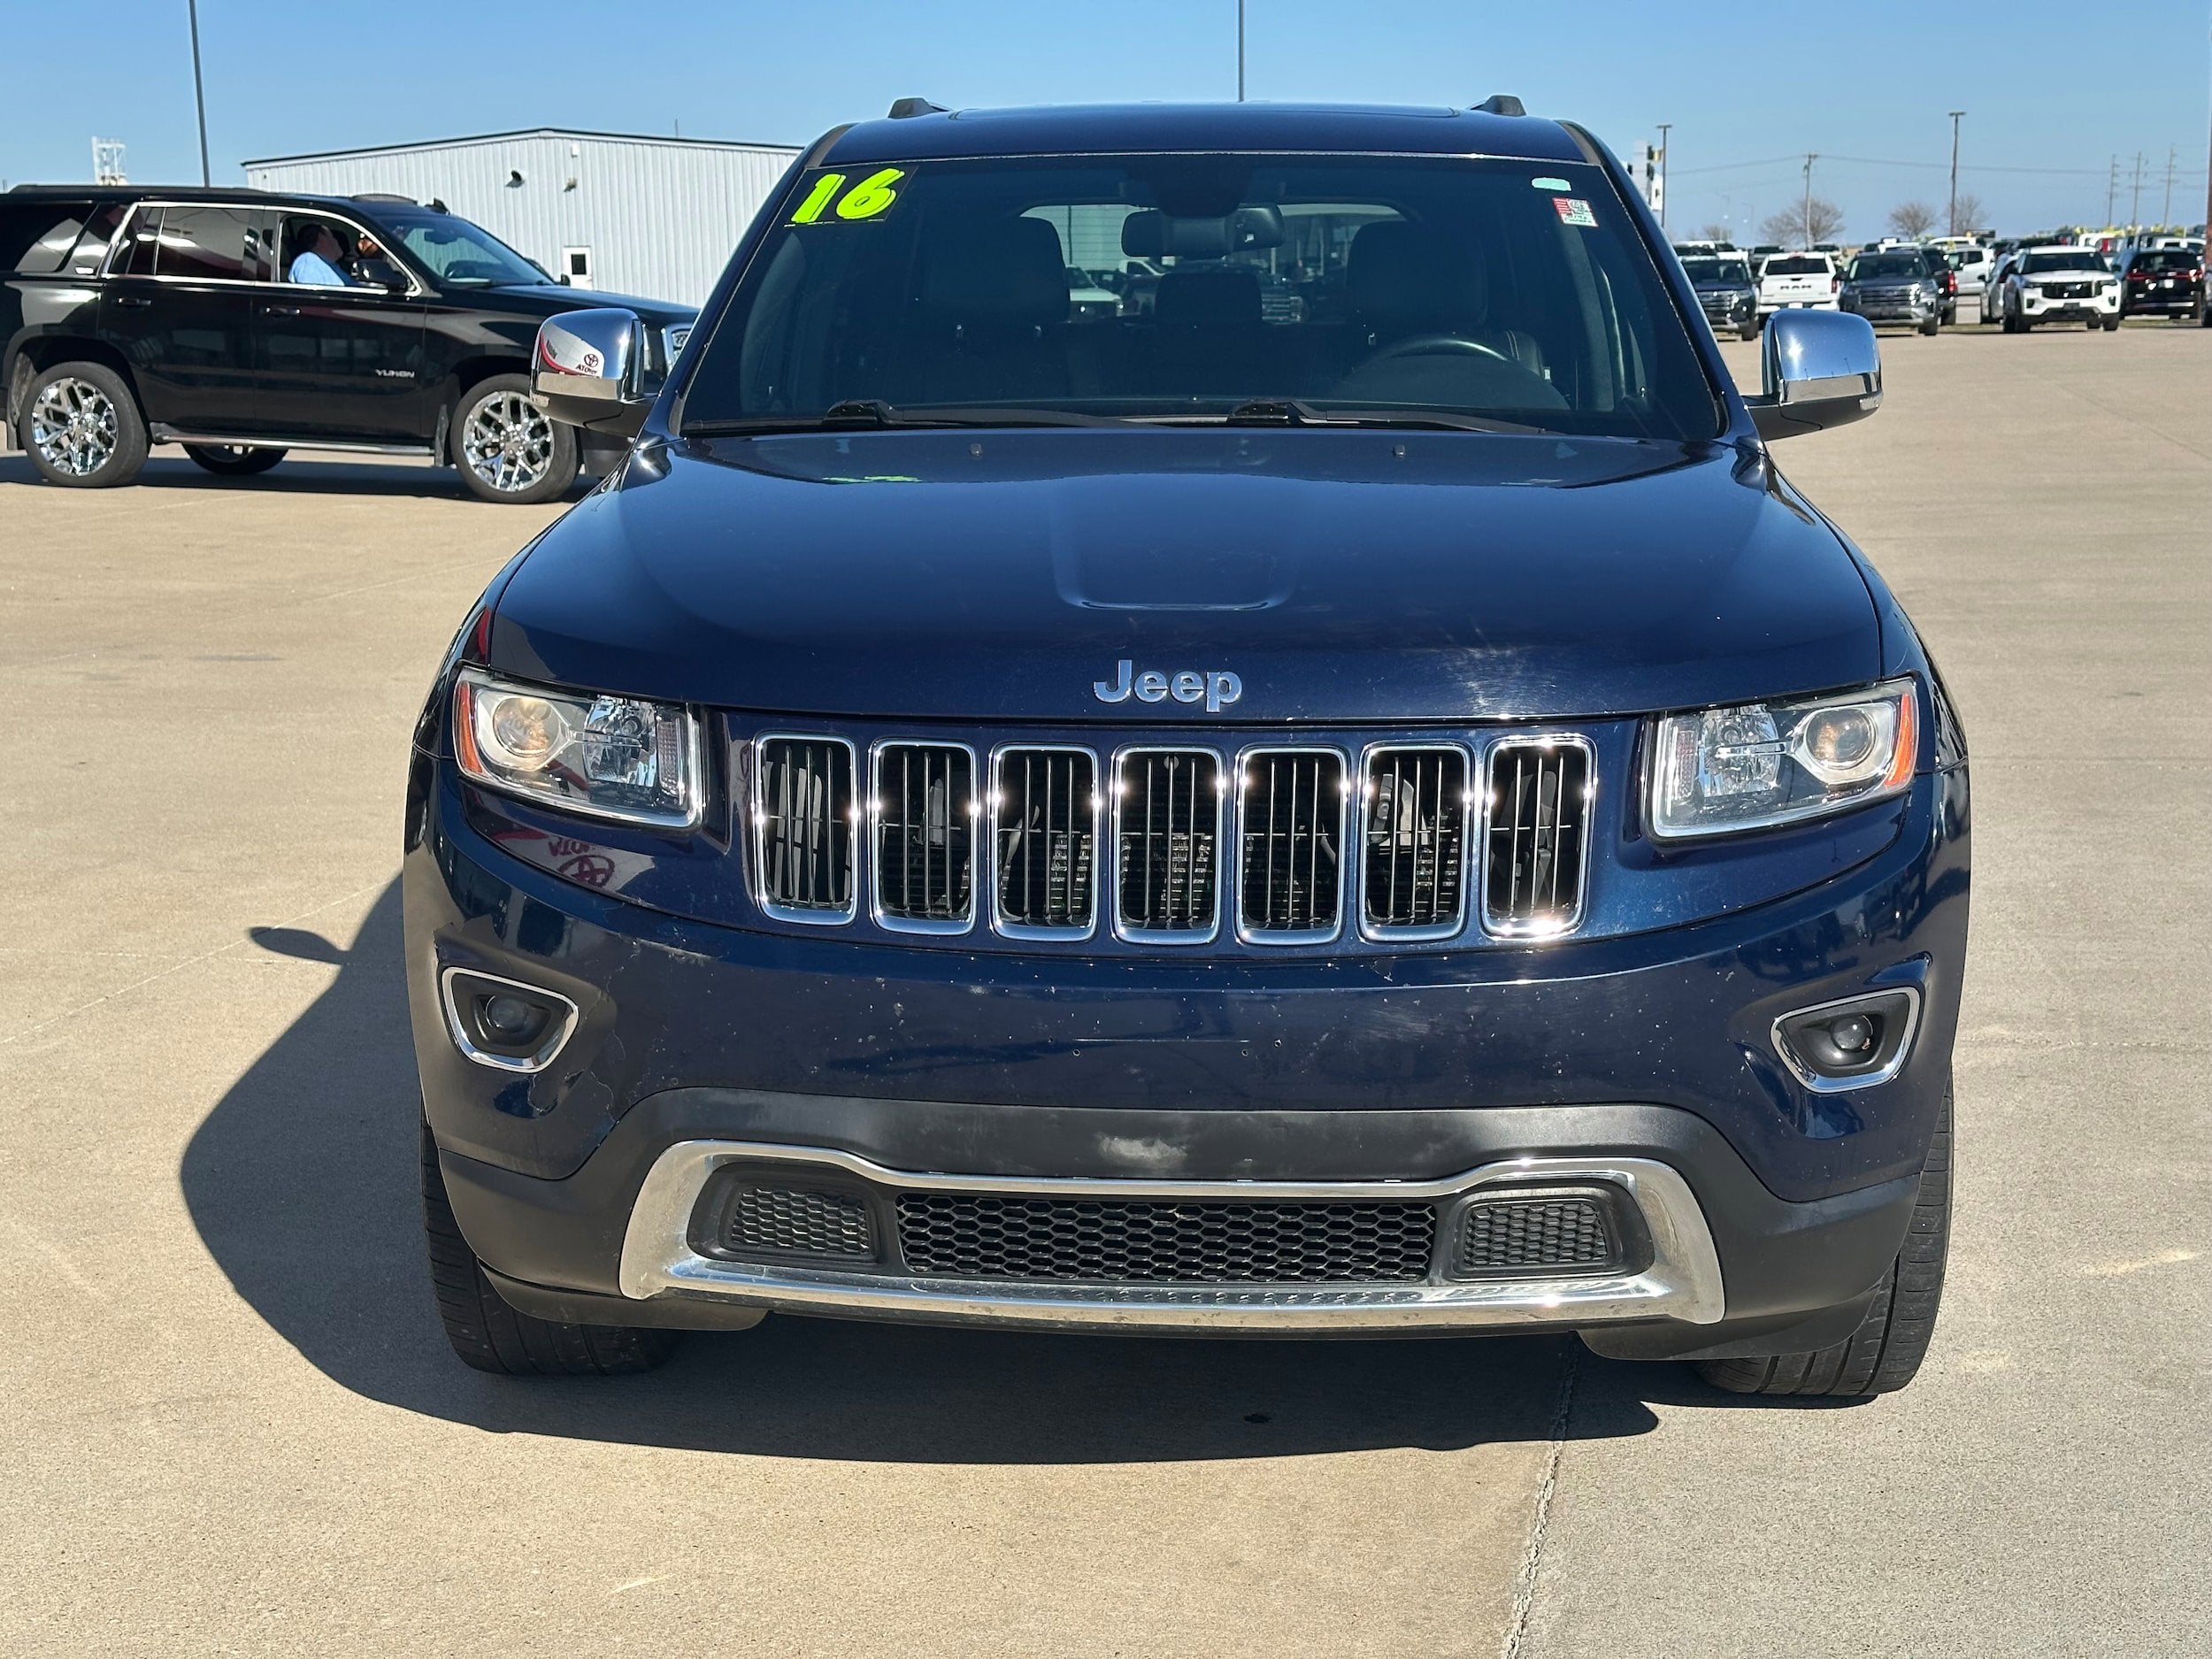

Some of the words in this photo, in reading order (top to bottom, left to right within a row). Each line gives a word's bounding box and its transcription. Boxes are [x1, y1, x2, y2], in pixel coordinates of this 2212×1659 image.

[790, 168, 905, 223] 16
[375, 368, 415, 378] YUKON
[1094, 659, 1243, 713] Jeep
